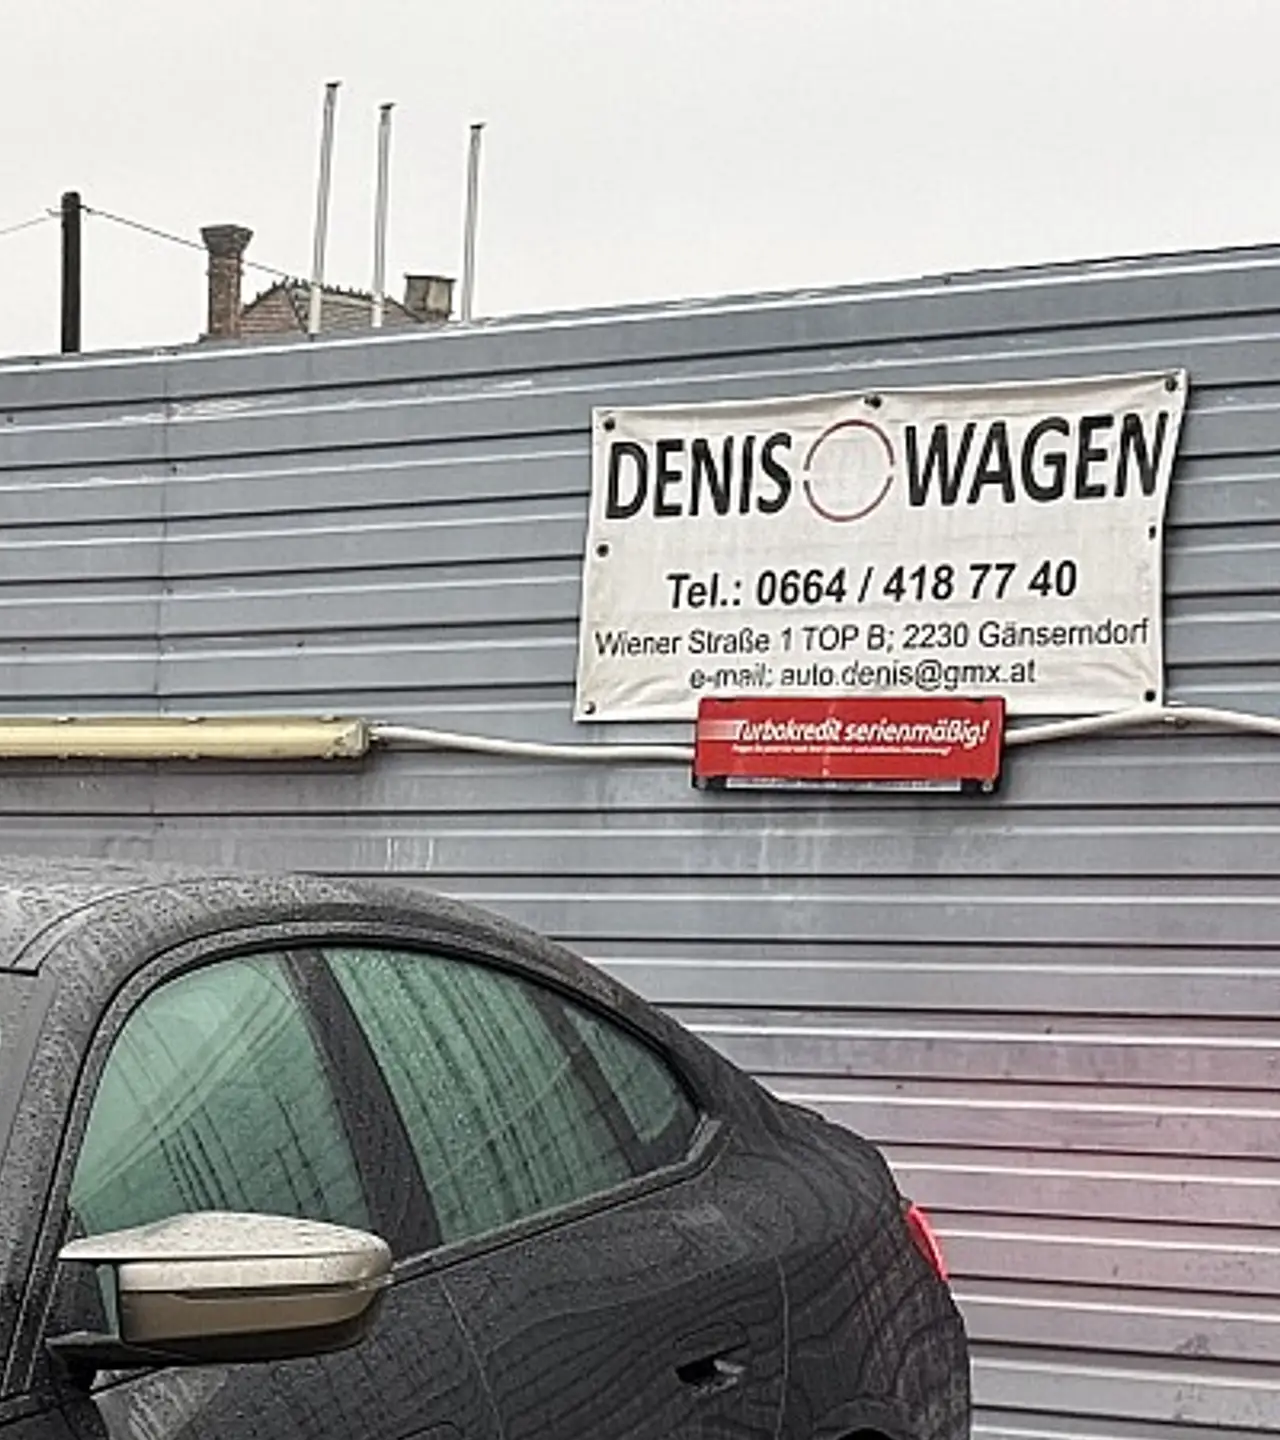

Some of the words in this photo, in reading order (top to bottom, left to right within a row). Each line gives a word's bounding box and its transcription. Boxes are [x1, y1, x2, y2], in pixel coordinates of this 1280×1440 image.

[605, 432, 792, 520] DENIS
[905, 411, 1169, 507] WAGEN
[667, 572, 741, 608] Tel.:
[756, 567, 847, 606] 0664
[857, 567, 874, 602] /
[883, 564, 955, 601] 418
[969, 562, 1017, 599] 77
[1028, 560, 1077, 597] 40
[595, 631, 683, 657] Wiener
[689, 626, 770, 654] Straße
[781, 627, 792, 651] 1
[802, 624, 859, 651] TOP
[867, 623, 895, 654] B;
[903, 622, 969, 649] 2230
[978, 618, 1150, 646] Gänserndorf
[780, 658, 1036, 691] auto.denis@gmx.at
